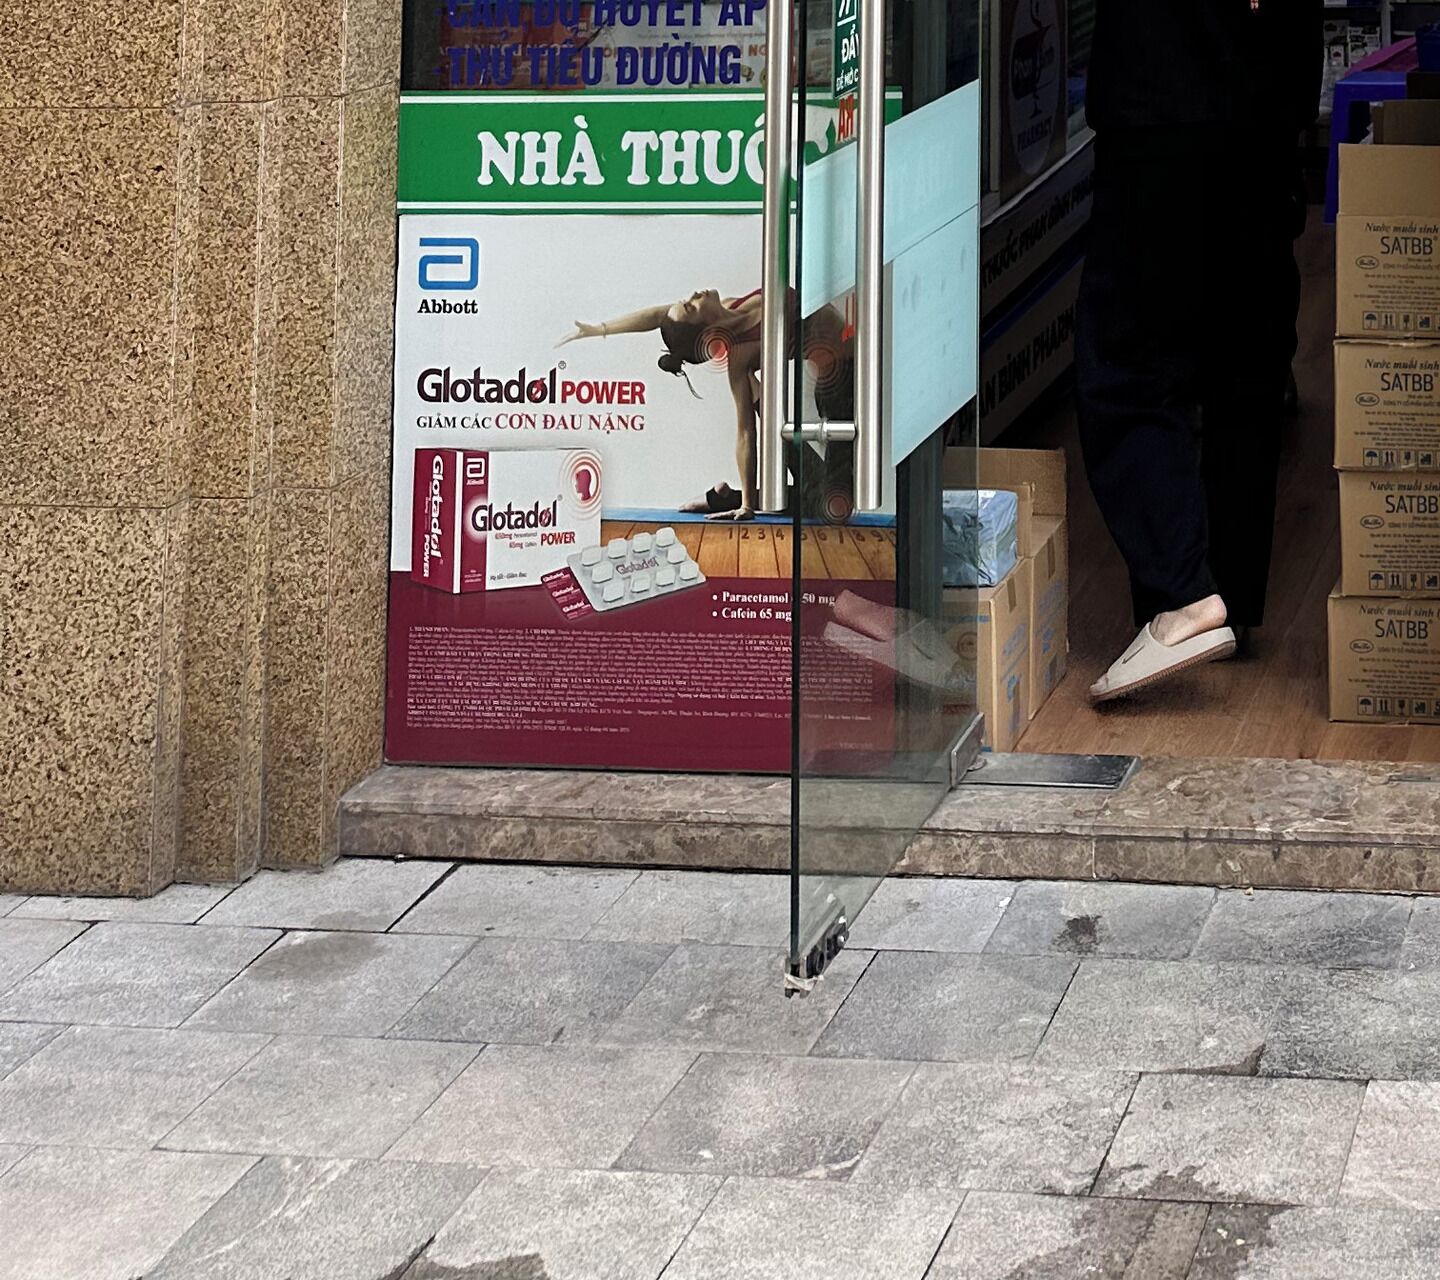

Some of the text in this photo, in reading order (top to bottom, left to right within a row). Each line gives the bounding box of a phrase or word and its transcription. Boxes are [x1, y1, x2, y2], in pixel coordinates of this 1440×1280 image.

[478, 115, 604, 186] NHÀ
[1381, 236, 1433, 255] SATBB
[418, 299, 478, 314] Abbott
[417, 366, 645, 404] Glotadol POWER
[1381, 372, 1433, 392] SATBB
[417, 412, 645, 434] GIẢM CÁC CƠN ĐAU NẶNG
[471, 499, 576, 545] Glotadol POWER
[722, 592, 788, 603] Paracetamol
[722, 608, 792, 621] Cafein 65 mg
